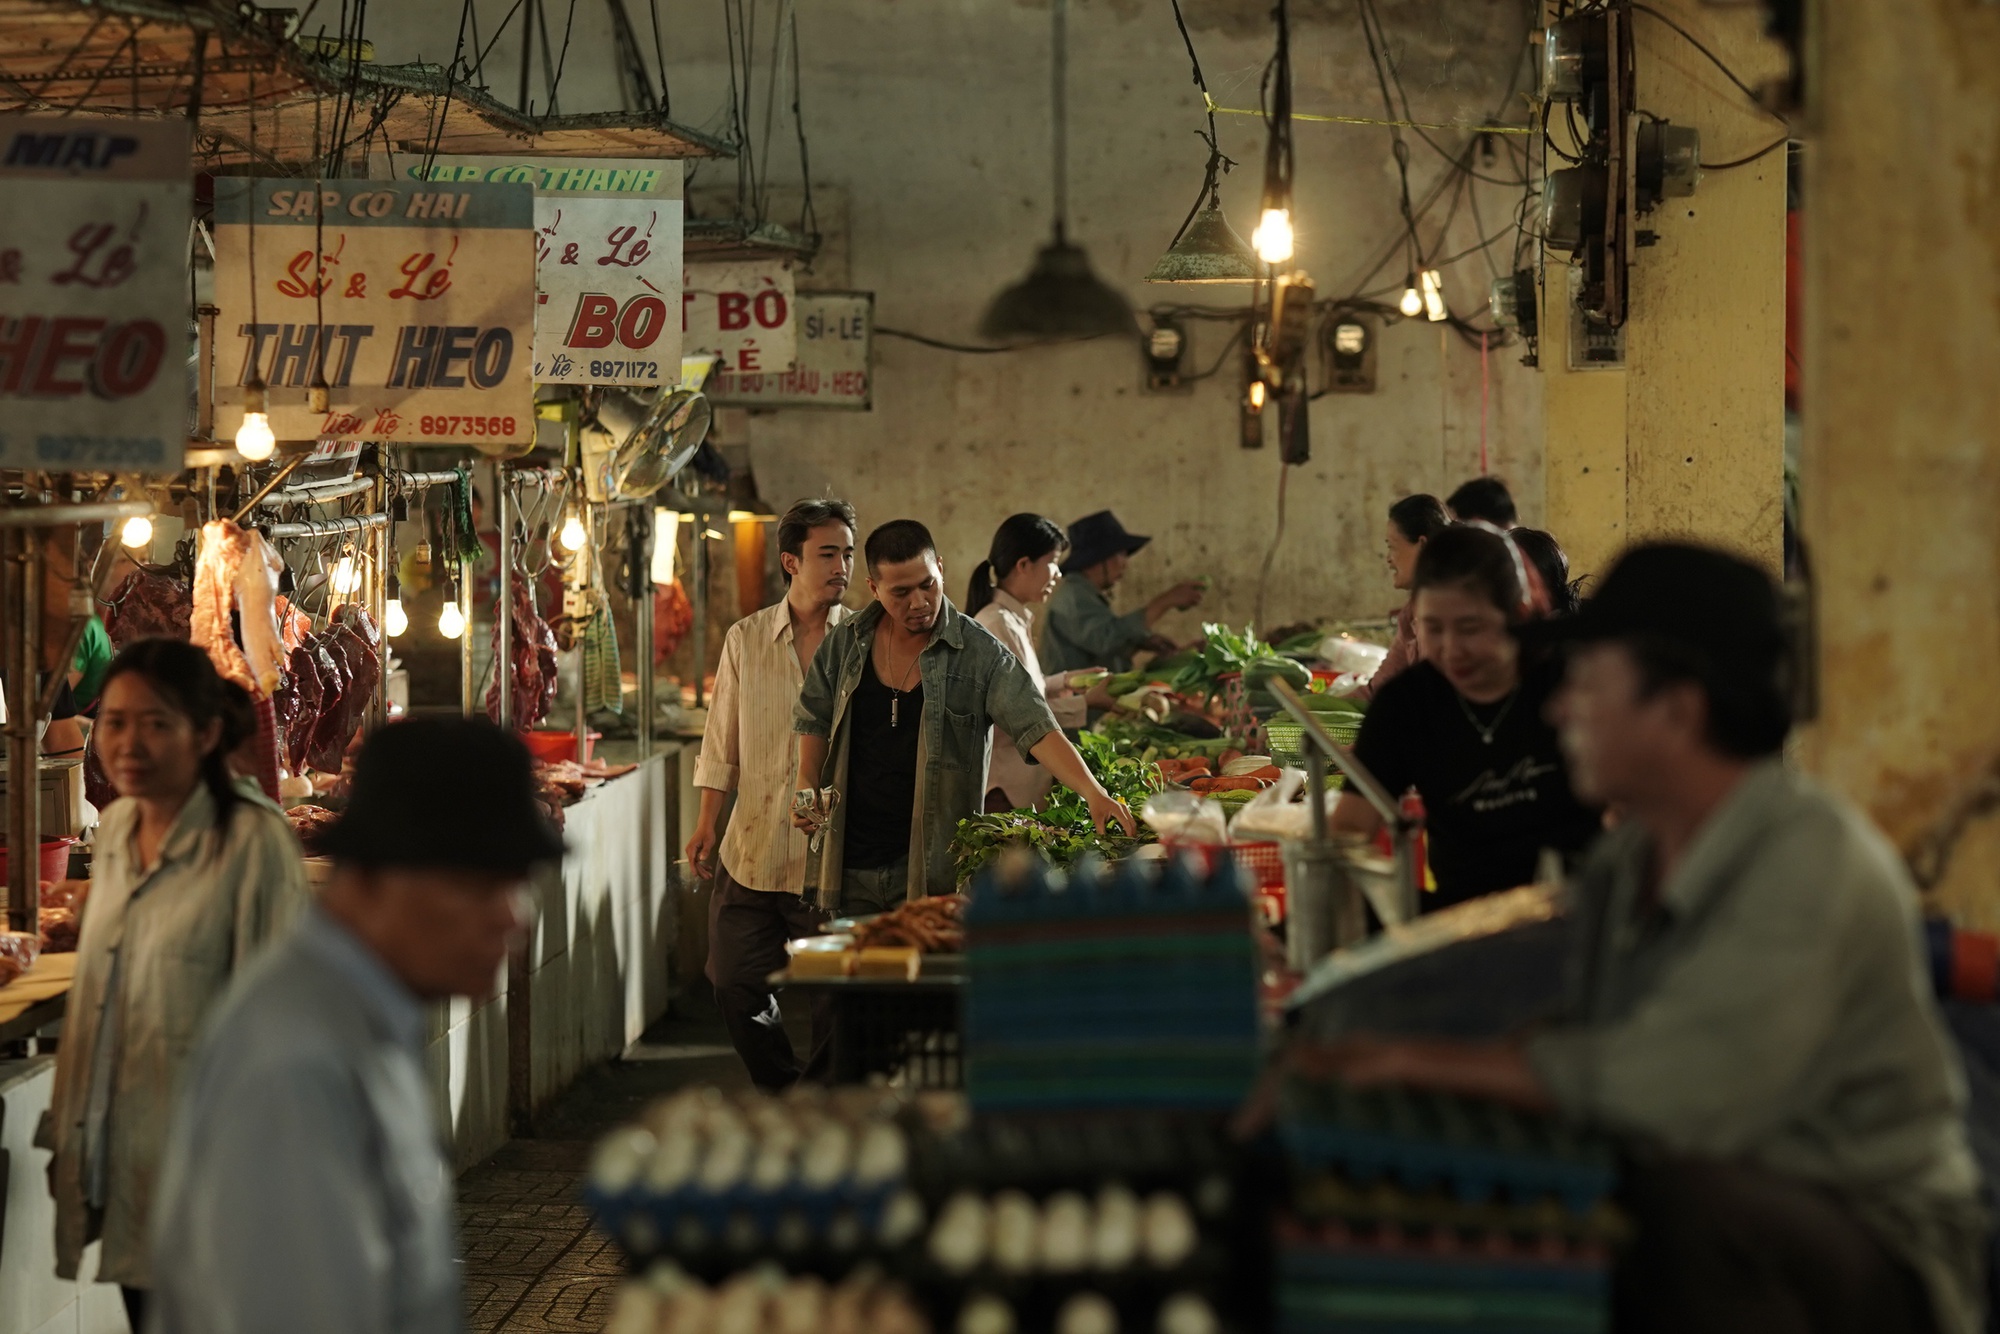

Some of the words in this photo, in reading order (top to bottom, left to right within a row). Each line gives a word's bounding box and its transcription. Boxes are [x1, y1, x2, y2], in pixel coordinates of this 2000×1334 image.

[540, 168, 663, 193] THANH
[405, 193, 472, 219] HAI
[560, 242, 579, 266] &
[345, 272, 367, 299] &
[562, 275, 667, 350] BÒ
[718, 275, 788, 332] BÒ
[386, 325, 514, 391] HEO
[589, 360, 658, 379] 8971172
[420, 414, 517, 437] 8973568
